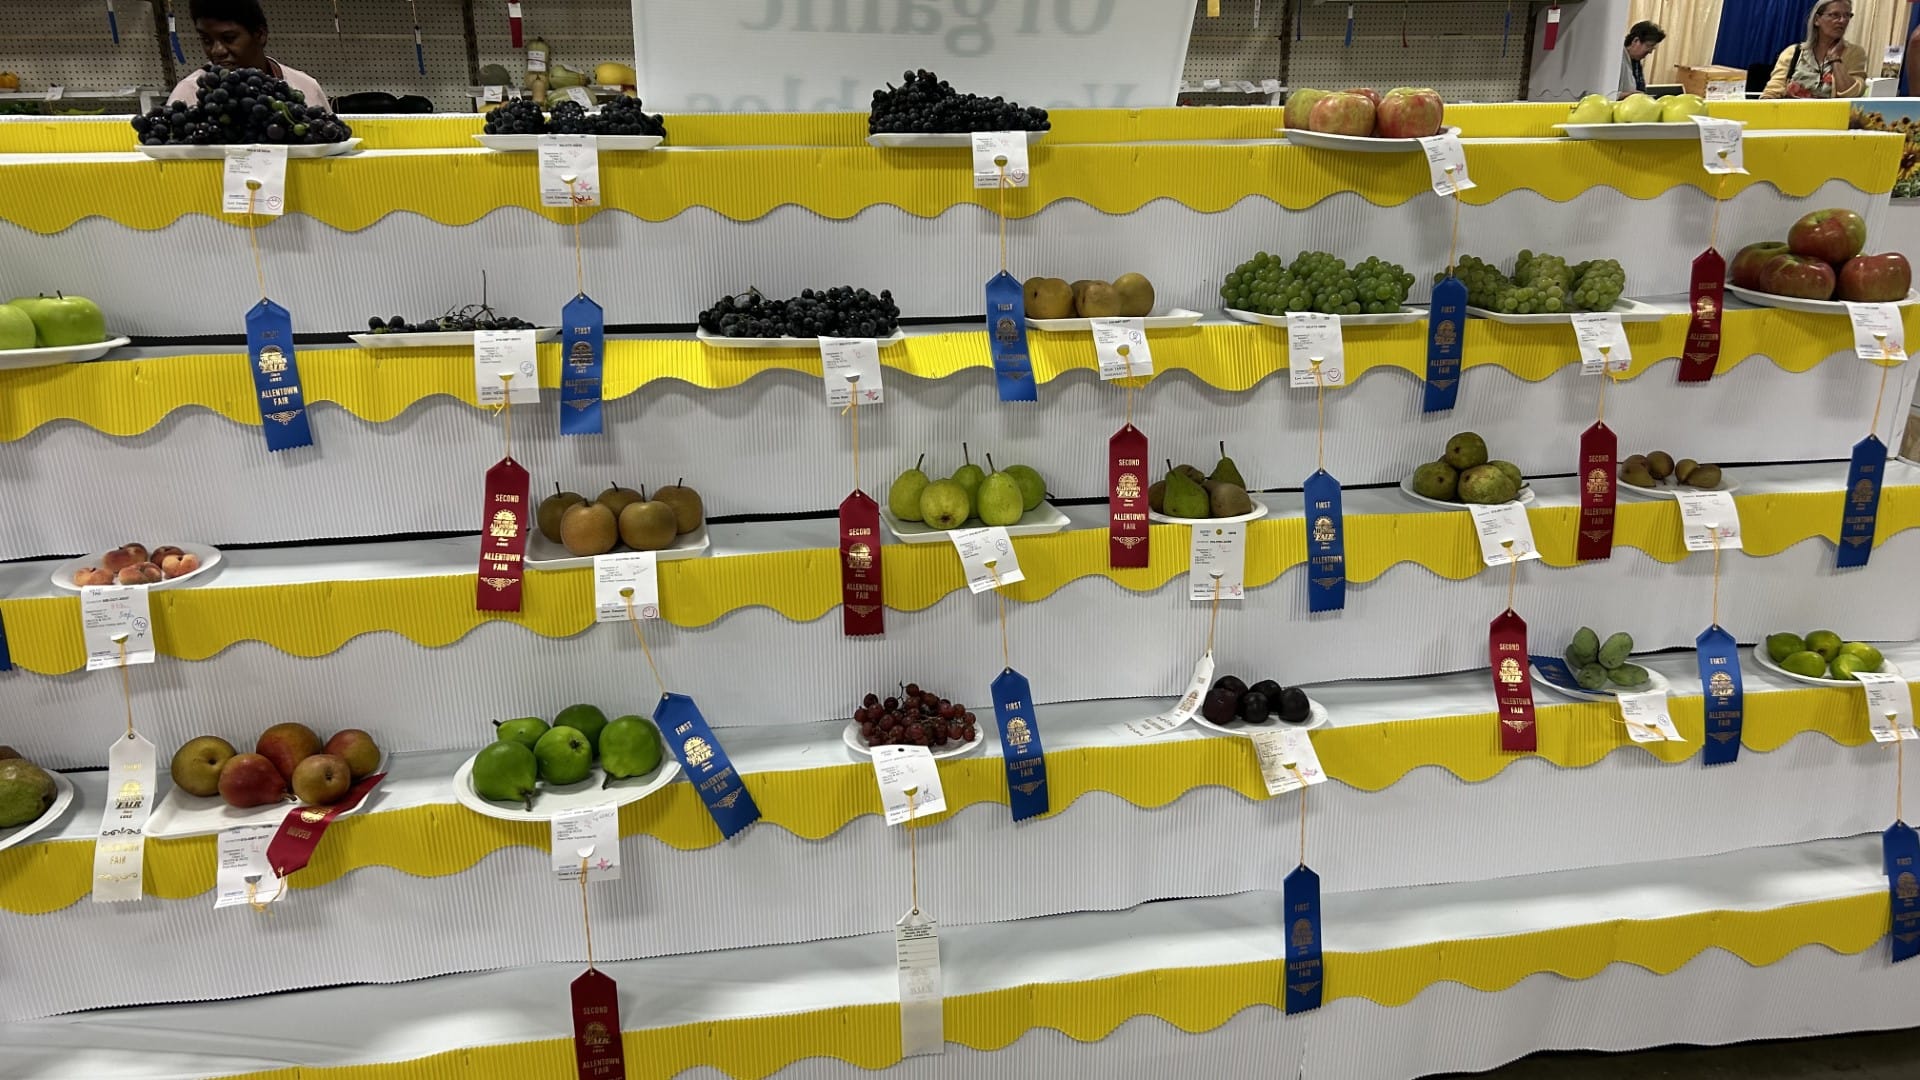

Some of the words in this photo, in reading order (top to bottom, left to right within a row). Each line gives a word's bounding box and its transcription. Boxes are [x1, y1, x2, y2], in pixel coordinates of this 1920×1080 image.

[574, 327, 591, 335] FIRST
[261, 386, 298, 399] ALLENTOWN
[273, 396, 289, 406] FAIR
[495, 494, 519, 503] SECOND
[1315, 502, 1331, 510] FIRST
[1113, 513, 1145, 521] ALLENTOWN
[849, 528, 871, 536] SECOND
[484, 553, 520, 562] ALLENTOWN
[1312, 555, 1342, 564] ALLENTOWN
[847, 583, 878, 591] ALLENTOWN
[856, 591, 869, 600] FAIR
[1499, 643, 1520, 651] SECOND
[1710, 657, 1726, 665] FIRST
[1005, 702, 1022, 711] FIRST
[1709, 711, 1740, 719] ALLENTOWN
[675, 723, 693, 735] FIRST
[1009, 757, 1041, 770] ALLENTOWN
[1020, 768, 1033, 777] FAIR
[700, 767, 733, 791] ALLENTOWN
[713, 782, 728, 794] FAIR
[110, 856, 126, 864] FAIR
[583, 1006, 608, 1015] SECOND
[583, 1058, 620, 1070] ALLENTOWN
[594, 1066, 609, 1076] FAIR
